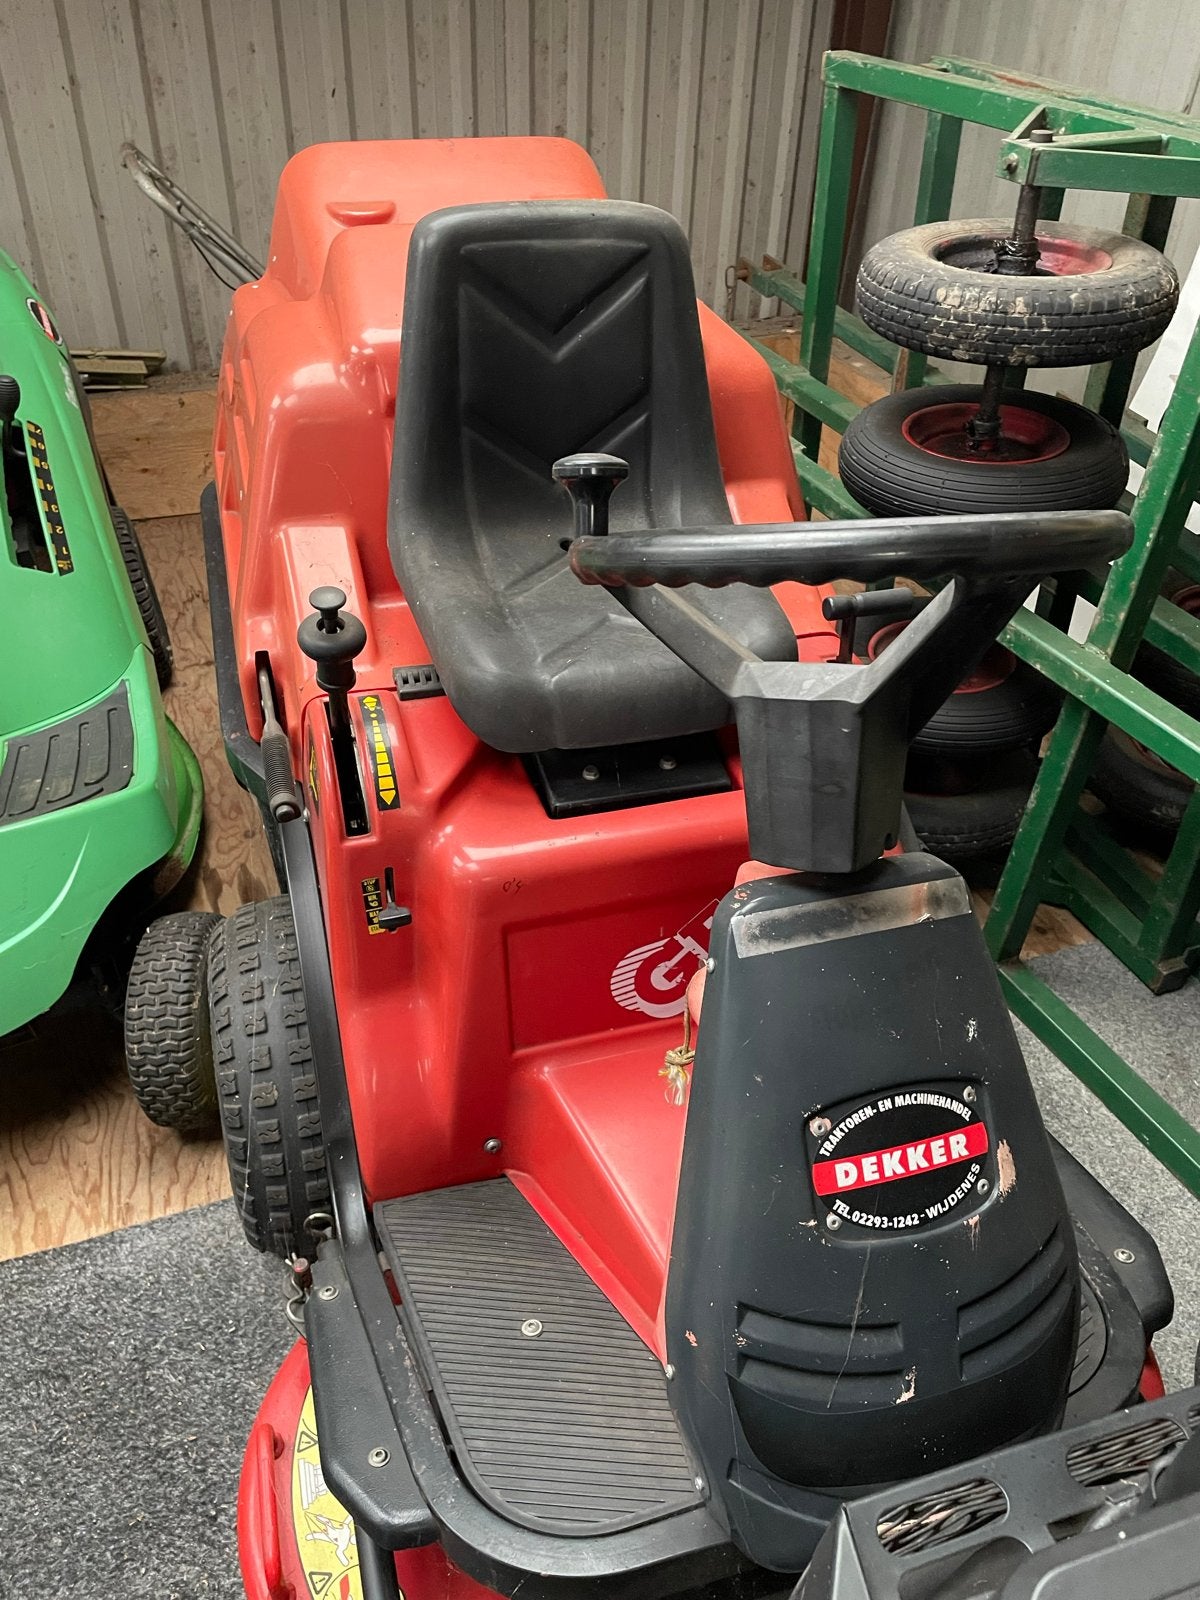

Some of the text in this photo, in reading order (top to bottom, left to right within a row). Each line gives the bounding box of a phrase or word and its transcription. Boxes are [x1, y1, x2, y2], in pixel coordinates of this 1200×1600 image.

[55, 525, 64, 534] 2
[819, 1093, 972, 1157] TRAKTOREN- EN MACHINEHANDEL
[834, 1133, 970, 1188] DEKKER
